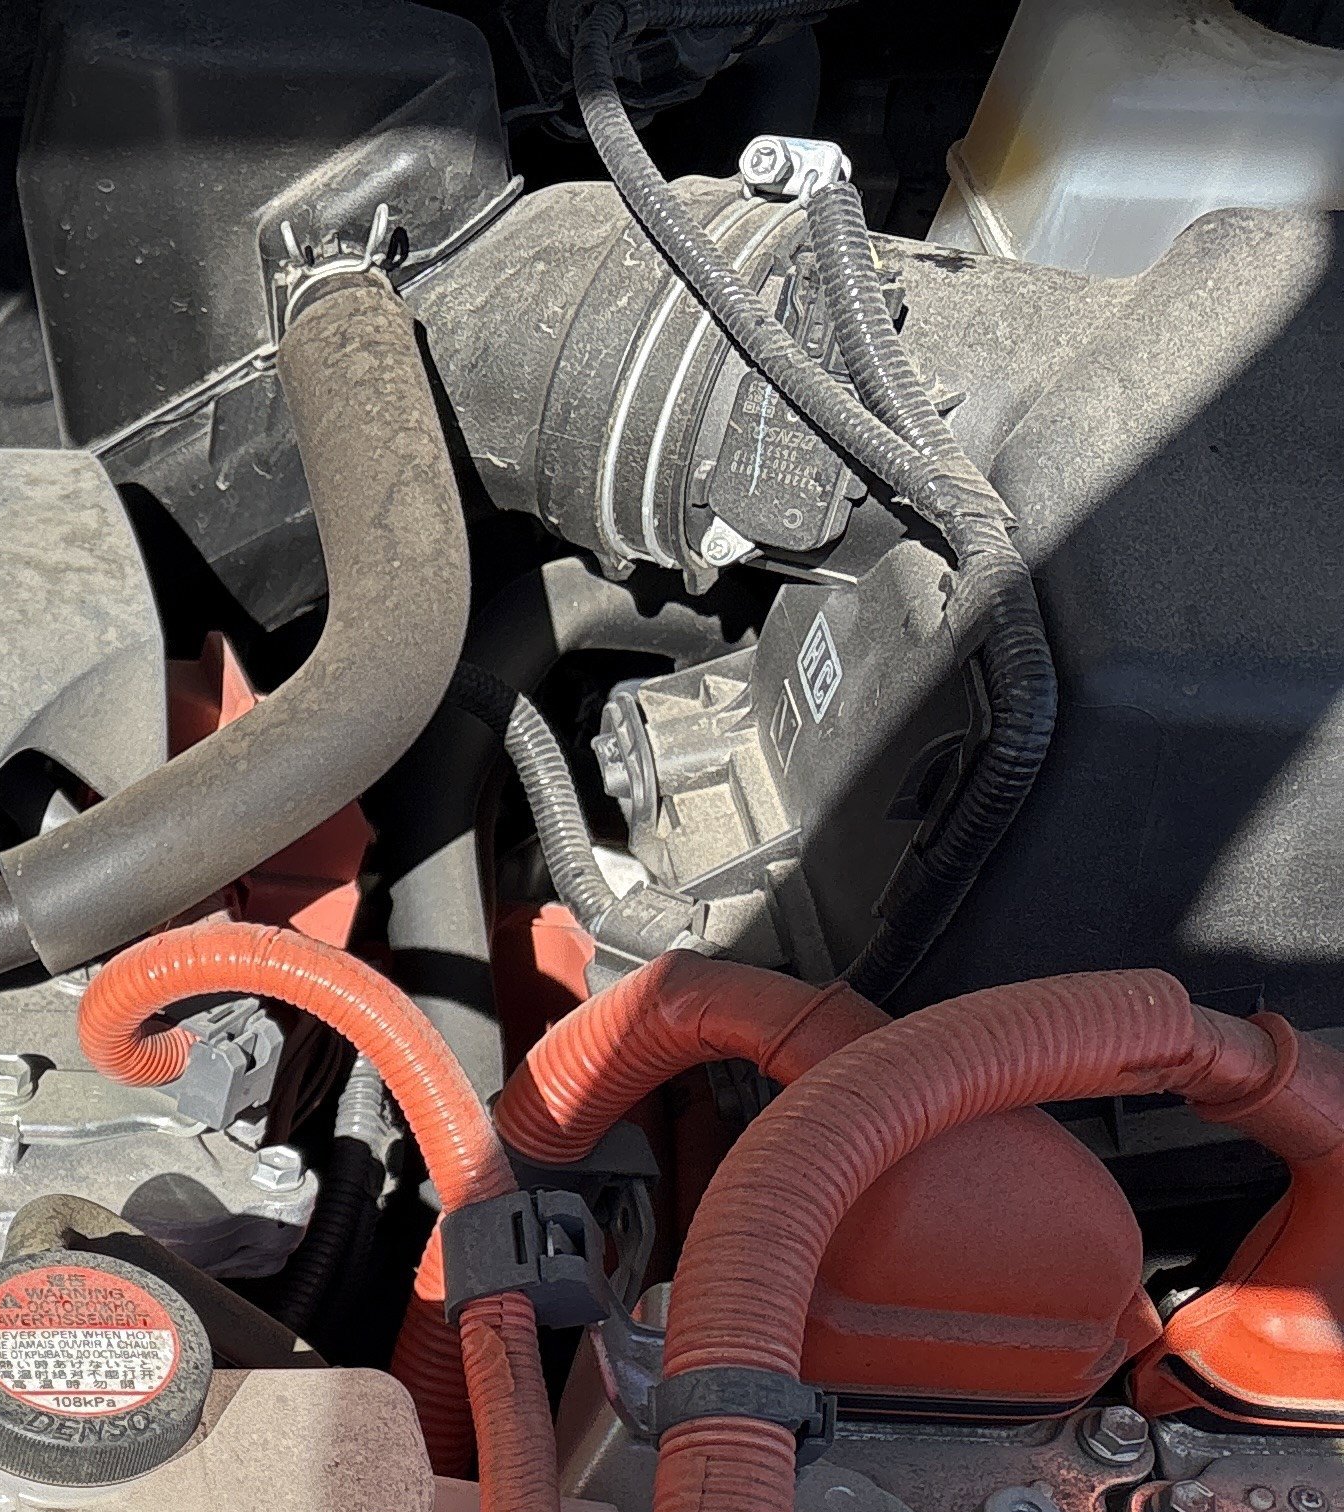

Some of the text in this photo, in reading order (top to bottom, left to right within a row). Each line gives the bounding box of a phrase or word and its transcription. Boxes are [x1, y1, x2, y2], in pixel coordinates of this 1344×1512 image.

[24, 1288, 126, 1301] WARNING
[41, 1331, 77, 1340] OPEN
[81, 1331, 121, 1340] WHEN
[12, 1340, 55, 1350] JAMAIS
[58, 1340, 102, 1350] OUVRIR
[52, 1396, 117, 1408] 108kPa
[22, 1411, 152, 1444] DENSO
